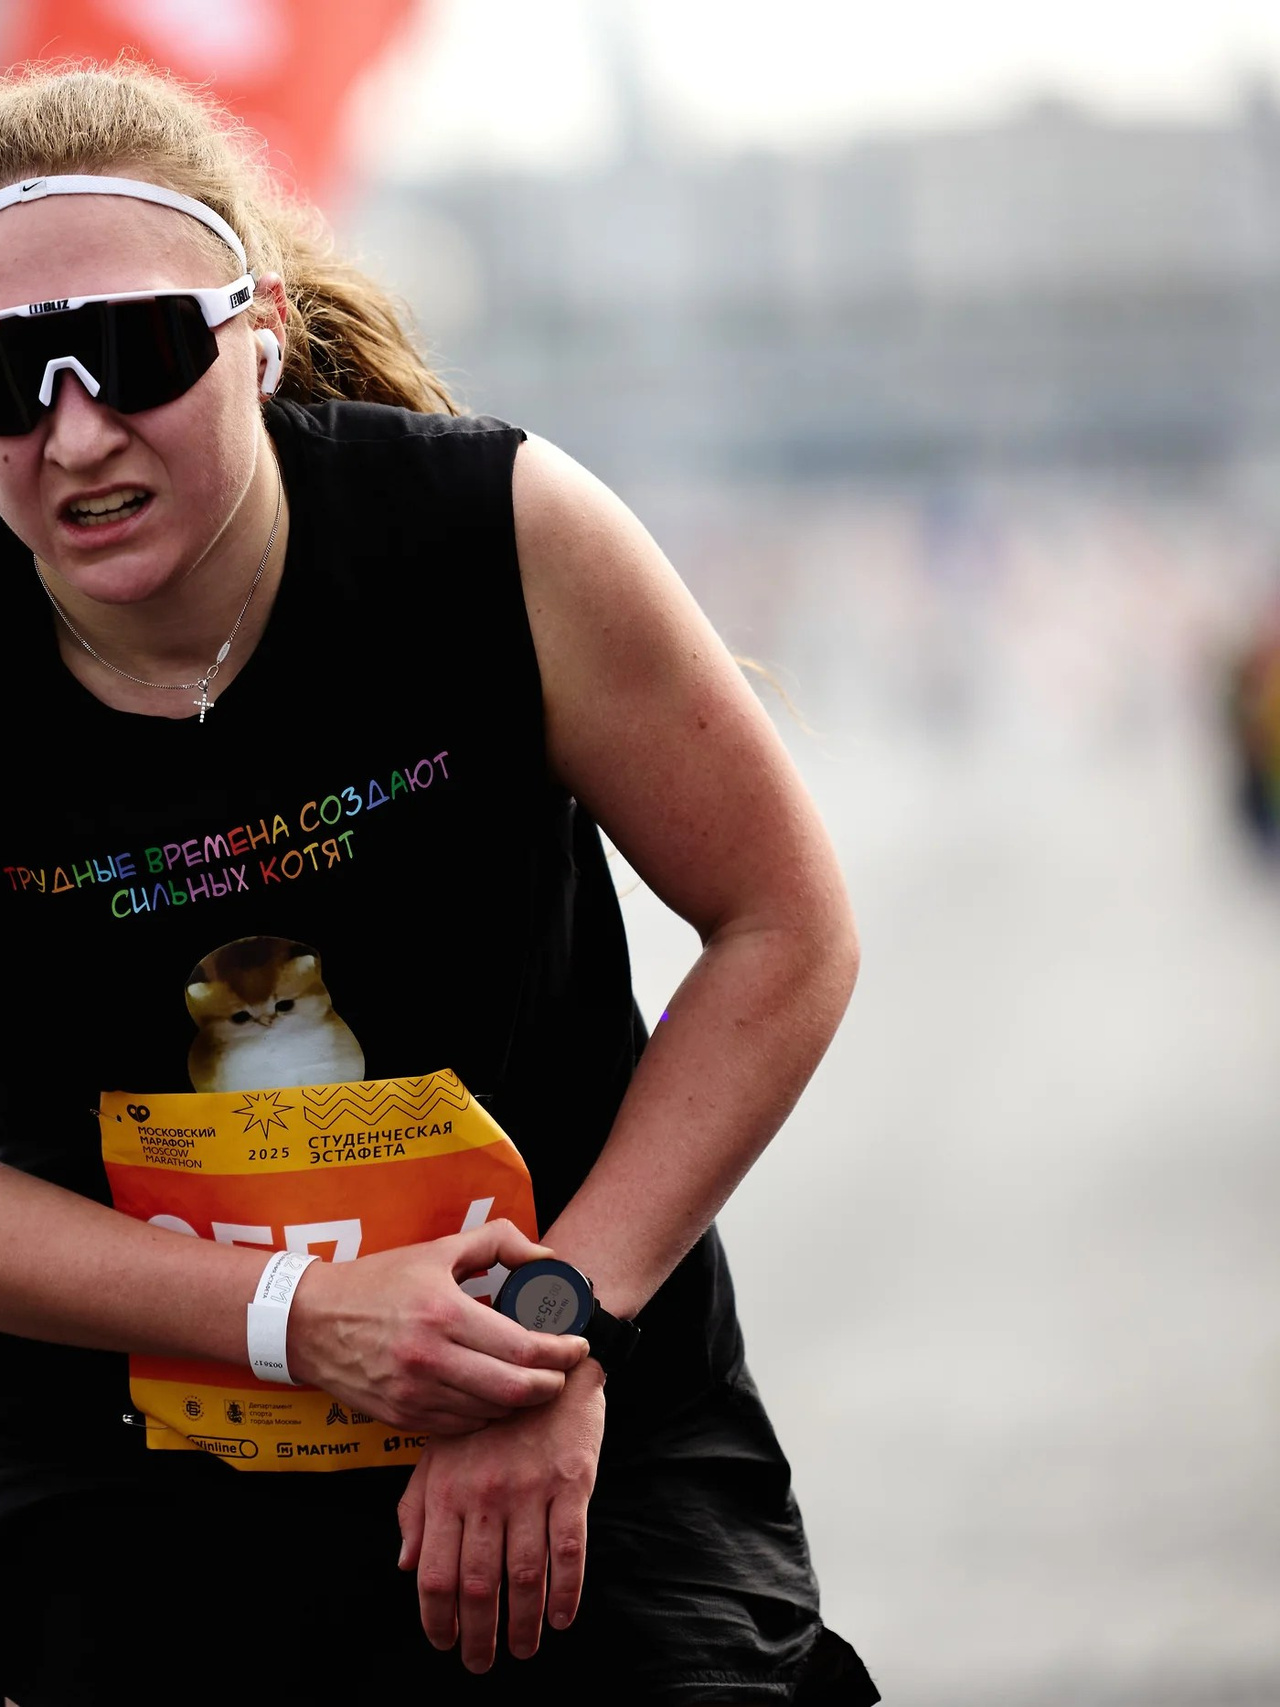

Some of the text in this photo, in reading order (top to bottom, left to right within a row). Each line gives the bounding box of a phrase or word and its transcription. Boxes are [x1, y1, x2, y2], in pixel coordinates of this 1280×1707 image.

[41, 298, 70, 313] BLIZ
[3, 750, 449, 893] ТРУДНЫЕ ВРЕМЕНА СОЗДАЮТ
[111, 829, 355, 918] СИЛЬНЫХ КОТЯТ
[138, 1126, 217, 1138] МОСКОВСКИЙ
[308, 1120, 453, 1149] СТУДЕНЧЕСКАЯ
[140, 1136, 195, 1148] МАРАФОН
[142, 1146, 189, 1158] MOSCOW
[248, 1147, 290, 1161] 2025
[309, 1143, 406, 1164] ЭСТАФЕТА
[145, 1154, 202, 1169] MARATHON
[249, 1402, 293, 1410] Департамент
[404, 1435, 431, 1448] ПС
[297, 1442, 360, 1456] МАГНИТ
